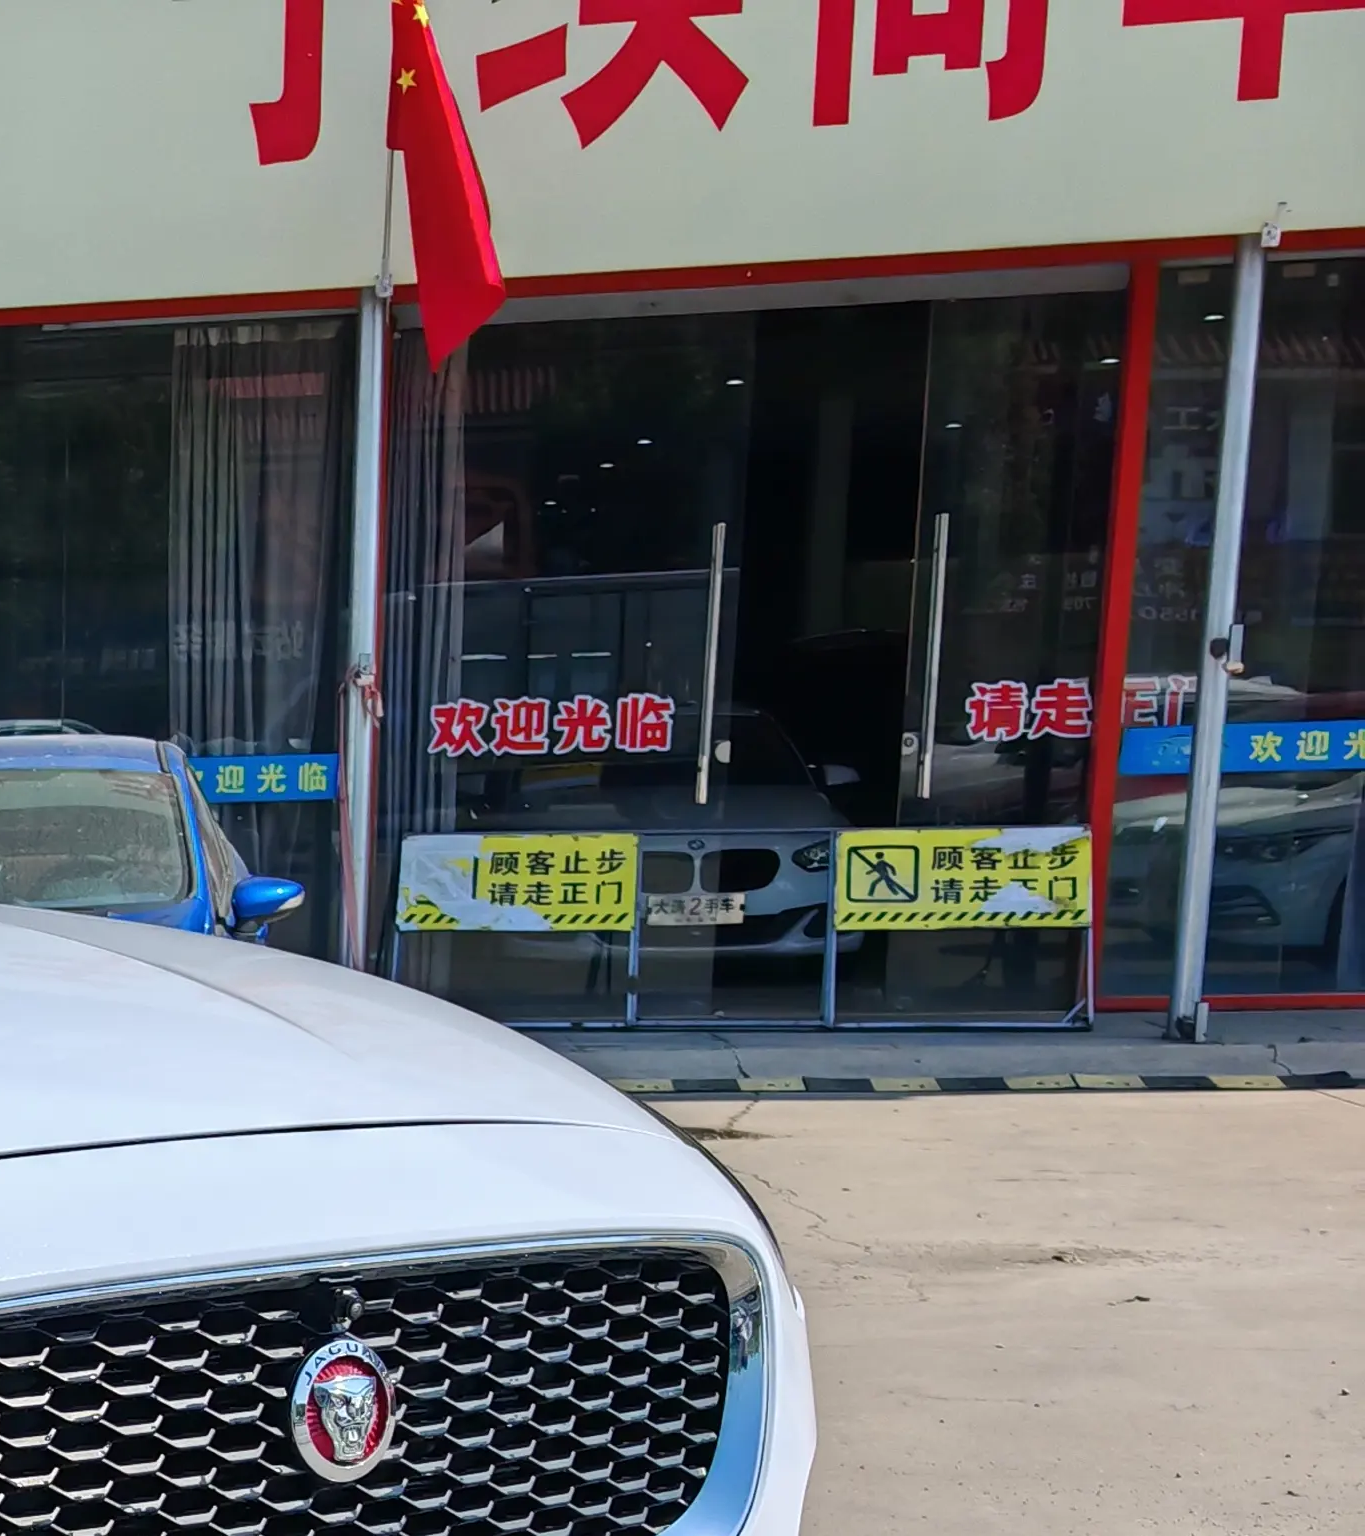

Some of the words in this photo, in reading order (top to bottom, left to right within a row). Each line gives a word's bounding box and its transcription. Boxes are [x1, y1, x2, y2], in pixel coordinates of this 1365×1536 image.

[427, 692, 676, 757] 欢迎光临
[195, 762, 327, 794] 迎光临
[488, 849, 626, 876] 顾客止步
[487, 879, 623, 907] 请走正门
